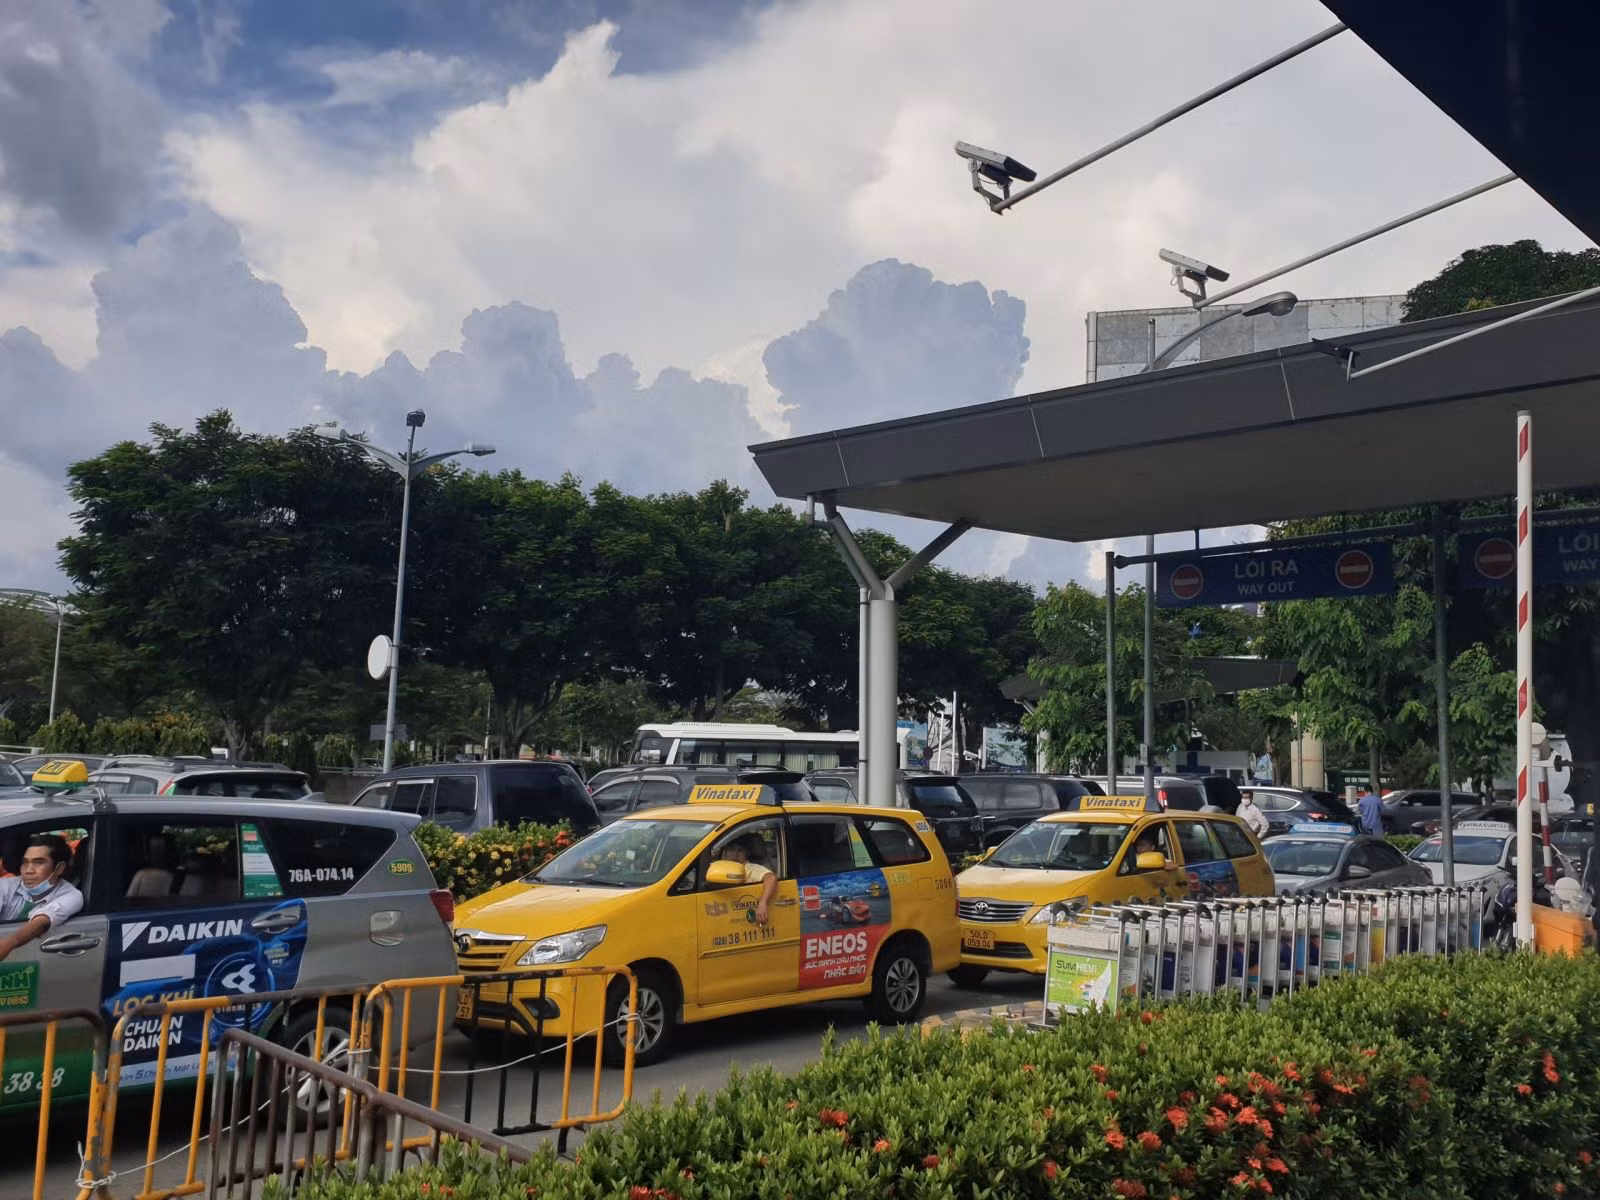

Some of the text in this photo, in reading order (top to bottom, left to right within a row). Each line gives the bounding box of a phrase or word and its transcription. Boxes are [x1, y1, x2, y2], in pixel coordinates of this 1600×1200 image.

[1271, 559, 1299, 577] RA
[1563, 558, 1599, 573] WAY
[1238, 581, 1295, 595] WAY OUT
[696, 787, 756, 800] Vinataxi
[1086, 797, 1142, 808] Vinataxi
[288, 867, 355, 882] 76A-074.14
[147, 919, 243, 944] DAIKIN
[806, 931, 868, 959] ENEOS
[123, 1030, 183, 1053] DAIKN
[4, 1071, 35, 1094] 38
